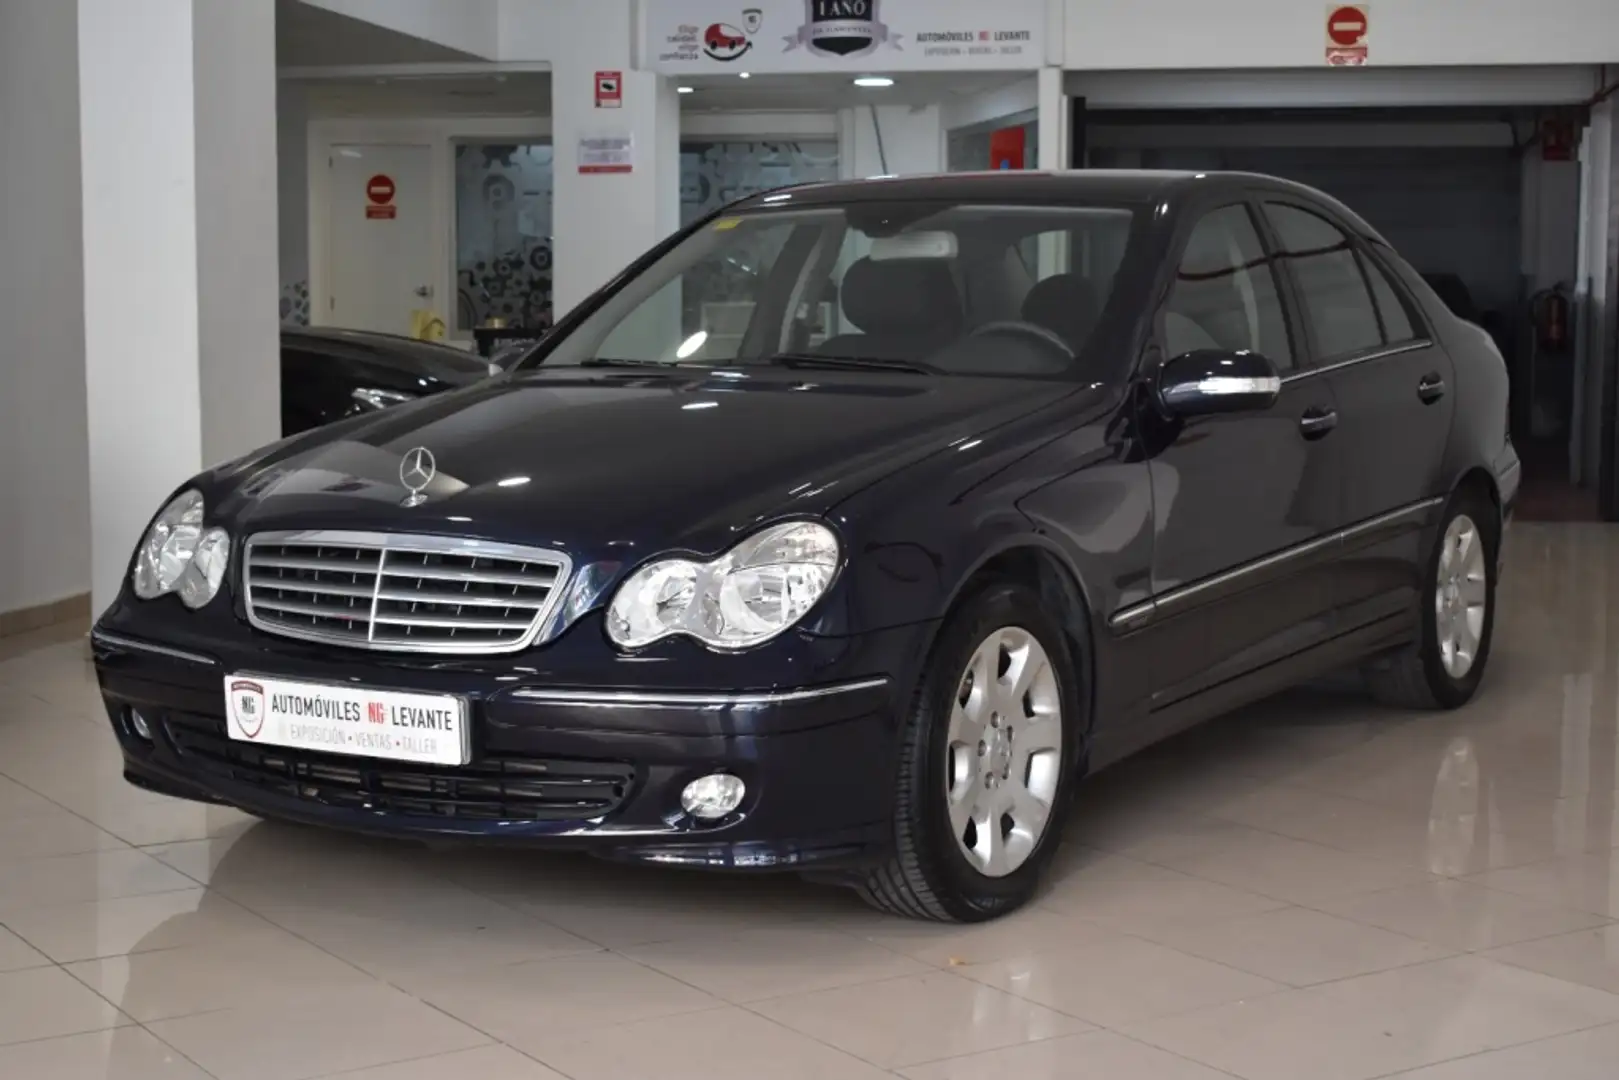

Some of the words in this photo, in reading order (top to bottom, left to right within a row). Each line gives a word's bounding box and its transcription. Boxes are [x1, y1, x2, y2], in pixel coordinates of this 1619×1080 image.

[994, 31, 1030, 41] LEVANTE
[271, 692, 361, 722] AUTOMÓVILES
[368, 702, 385, 724] NG
[392, 706, 453, 731] LEVANTE
[290, 723, 346, 745] EXPOSICIÓN
[355, 732, 392, 751] VENTAS
[403, 736, 438, 755] TALLER
